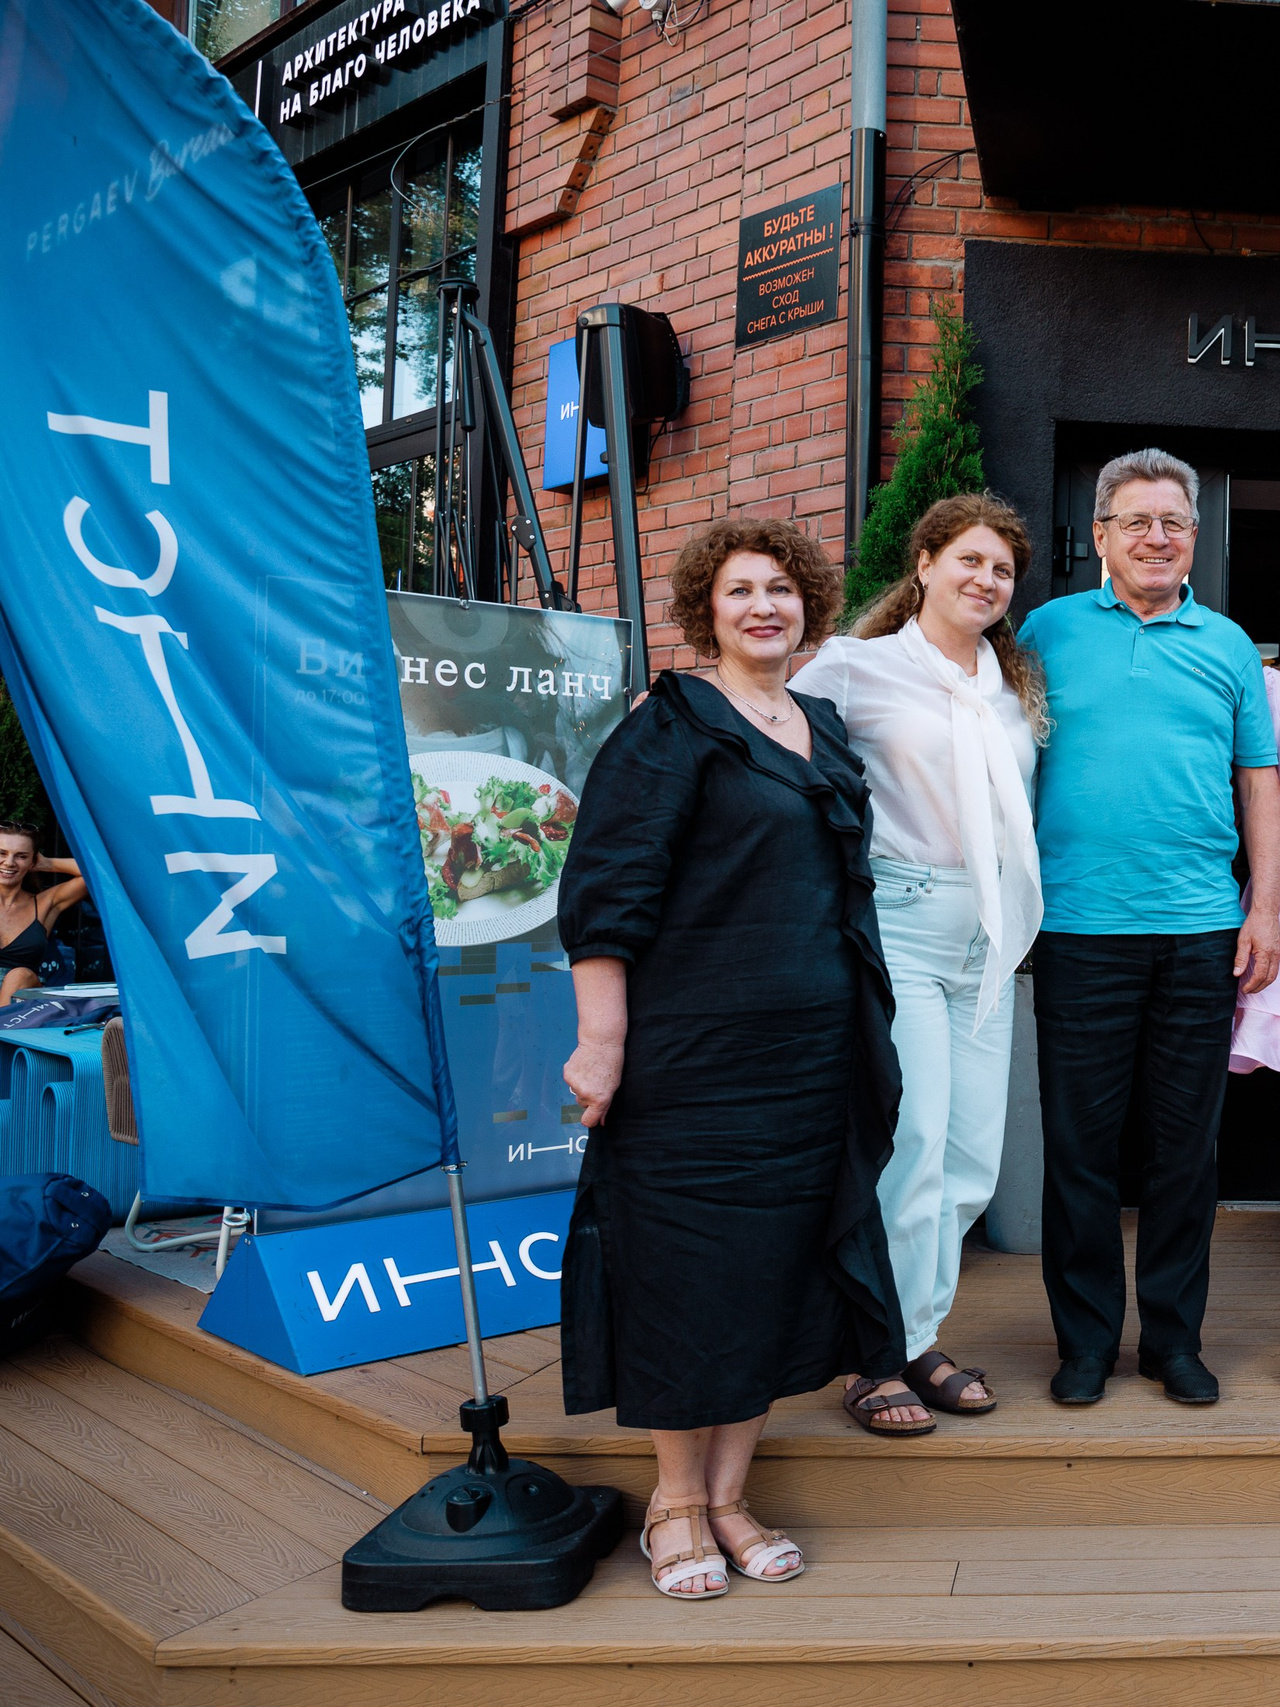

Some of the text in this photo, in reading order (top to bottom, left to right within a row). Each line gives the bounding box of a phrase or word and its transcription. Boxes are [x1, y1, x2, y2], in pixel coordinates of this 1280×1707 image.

[282, 0, 405, 86] АРХИТЕКТУРА
[279, 0, 480, 124] НА БЛАГО ЧЕЛОВЕКА
[763, 204, 815, 238] БУДЬТЕ
[744, 225, 826, 269] АККУРАТНЫ
[759, 267, 815, 296] ВОЗМОЖЕН
[772, 289, 799, 309] СХОД
[747, 299, 824, 334] СНЕГА С КРЫШИ
[506, 665, 612, 701] ланч
[508, 1135, 589, 1163] ИНС
[306, 1231, 563, 1322] ИНС
